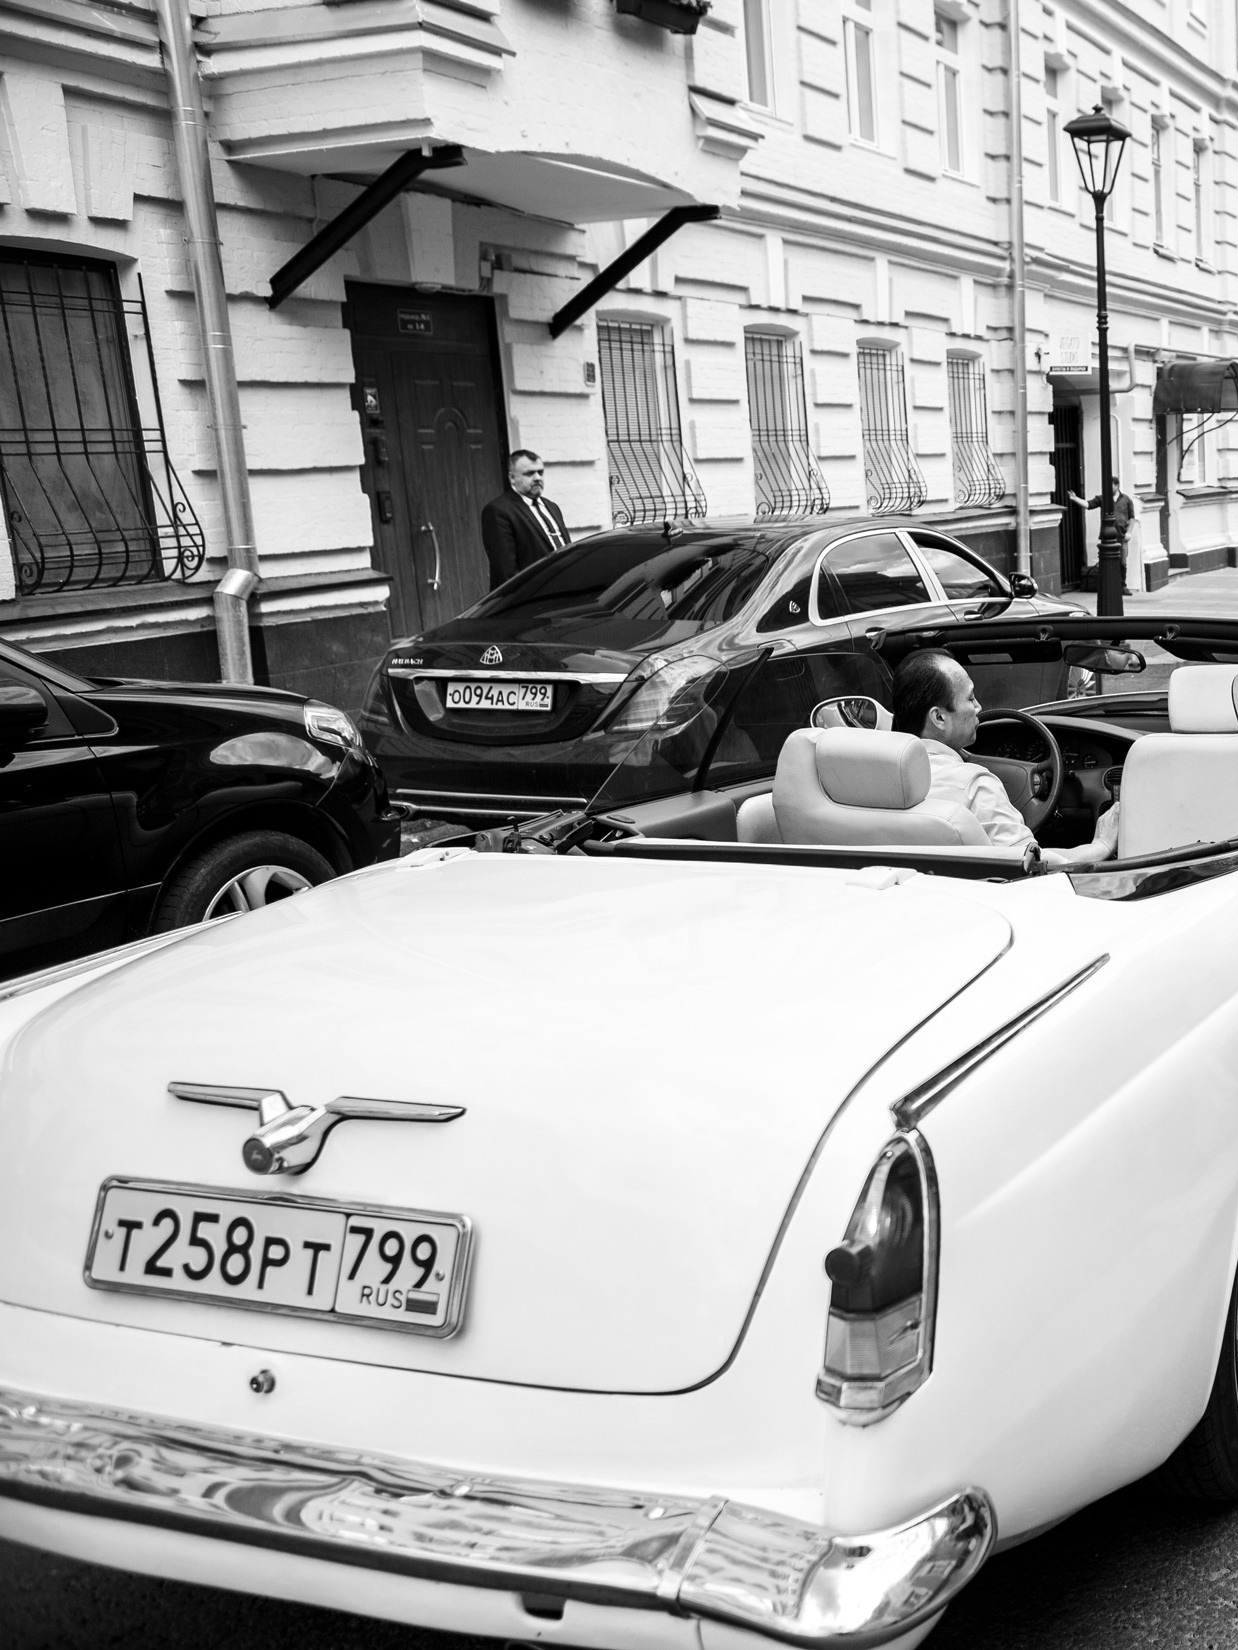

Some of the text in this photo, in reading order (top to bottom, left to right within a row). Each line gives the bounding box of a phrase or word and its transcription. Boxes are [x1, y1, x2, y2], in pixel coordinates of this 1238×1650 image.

[520, 685, 548, 702] 799
[116, 1207, 439, 1296] Т258РТ 799
[359, 1285, 404, 1310] RUS
